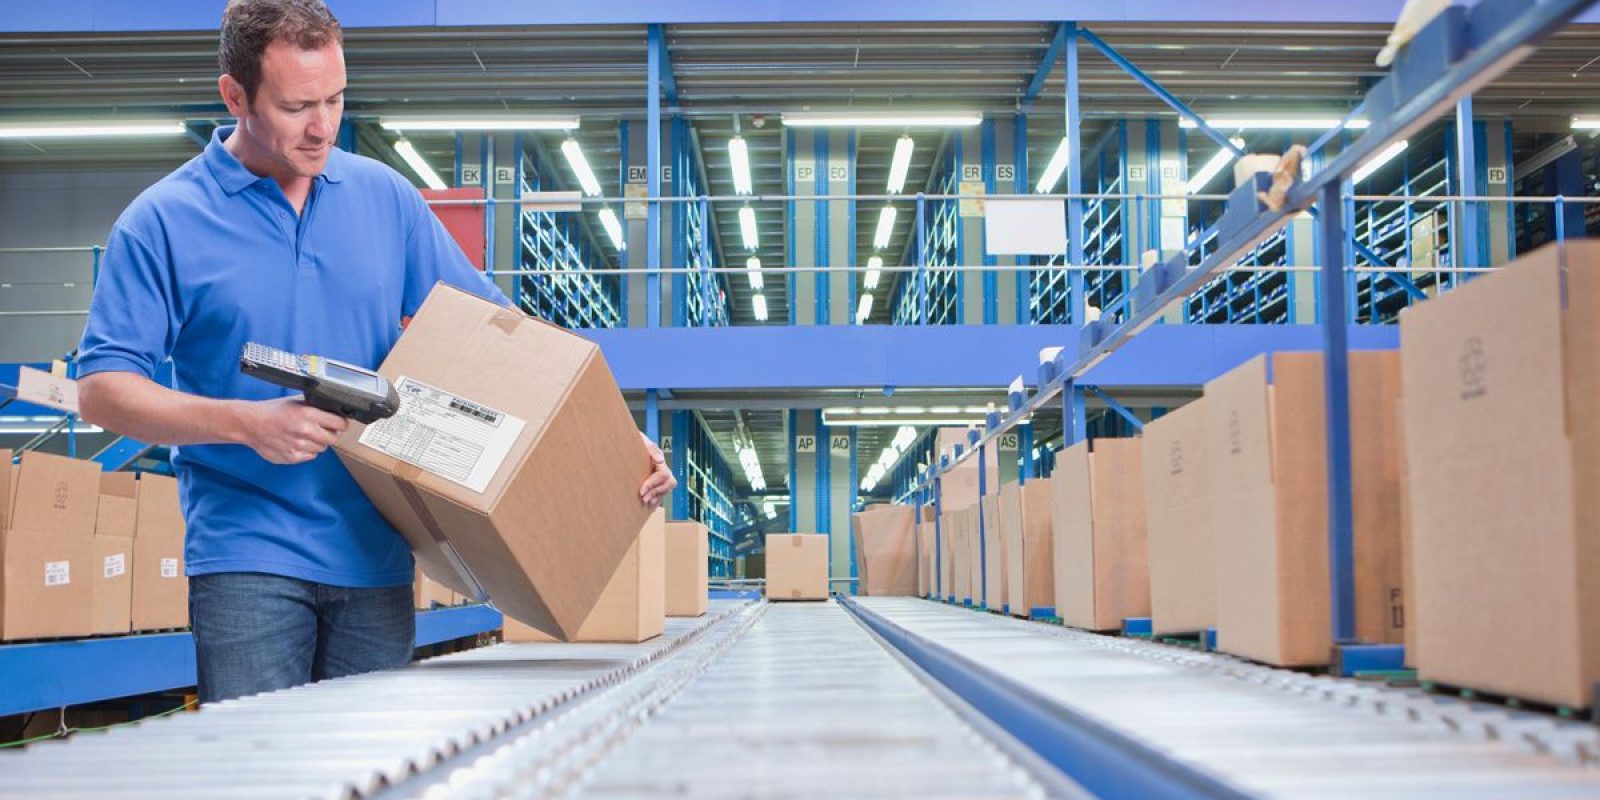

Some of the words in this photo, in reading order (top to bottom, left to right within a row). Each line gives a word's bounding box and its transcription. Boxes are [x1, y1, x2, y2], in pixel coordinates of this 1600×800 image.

[463, 169, 479, 182] EK
[498, 169, 512, 181] EL
[629, 167, 646, 180] EM
[664, 167, 671, 180] E
[799, 167, 812, 179] EP
[964, 166, 980, 179] ER
[998, 166, 1013, 179] ES
[1130, 167, 1144, 179] ET
[1163, 167, 1178, 179] EU
[1489, 169, 1505, 181] FD
[663, 438, 671, 450] A
[798, 438, 813, 449] AP
[832, 437, 849, 450] AQ
[1000, 435, 1017, 449] AS
